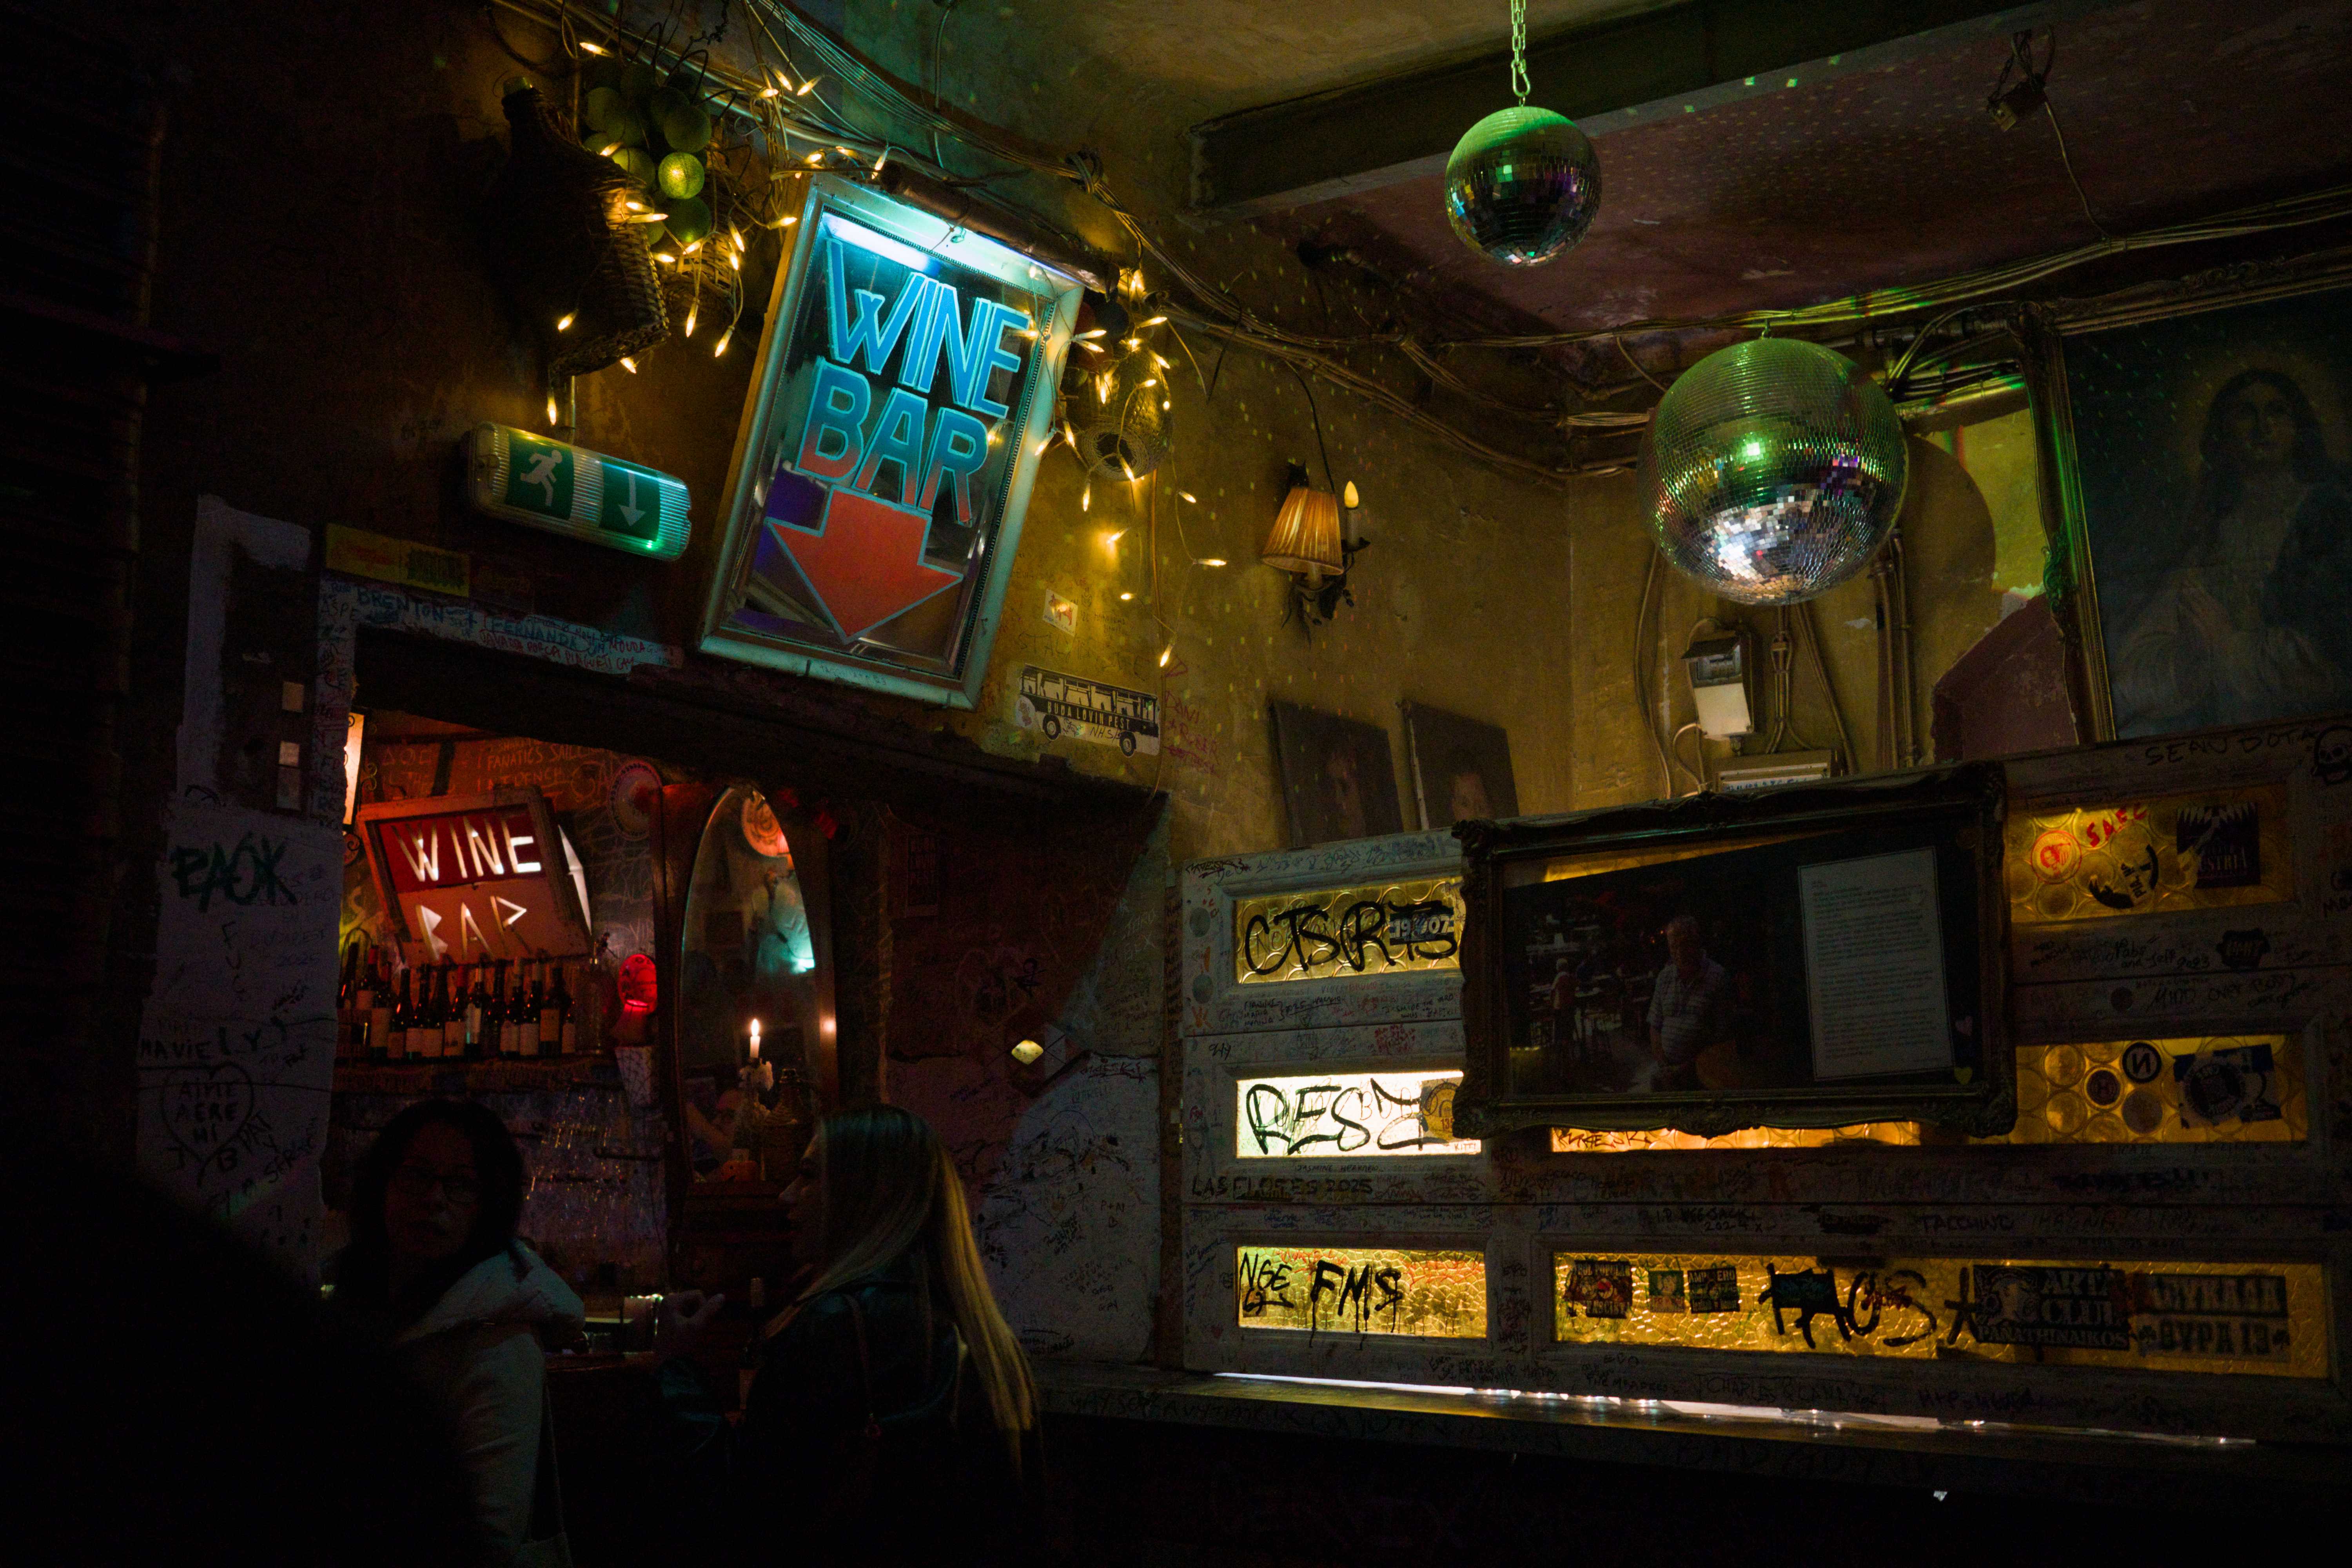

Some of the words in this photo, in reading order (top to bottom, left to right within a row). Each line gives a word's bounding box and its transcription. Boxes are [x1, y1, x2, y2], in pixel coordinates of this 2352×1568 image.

[826, 238, 1029, 419] WINE
[795, 356, 989, 527] BAR
[1047, 701, 1072, 718] BUDA
[1076, 706, 1104, 726] LOVIN
[1108, 716, 1131, 730] PEST
[391, 815, 542, 882] WINE
[1325, 1178, 1373, 1194] 2025
